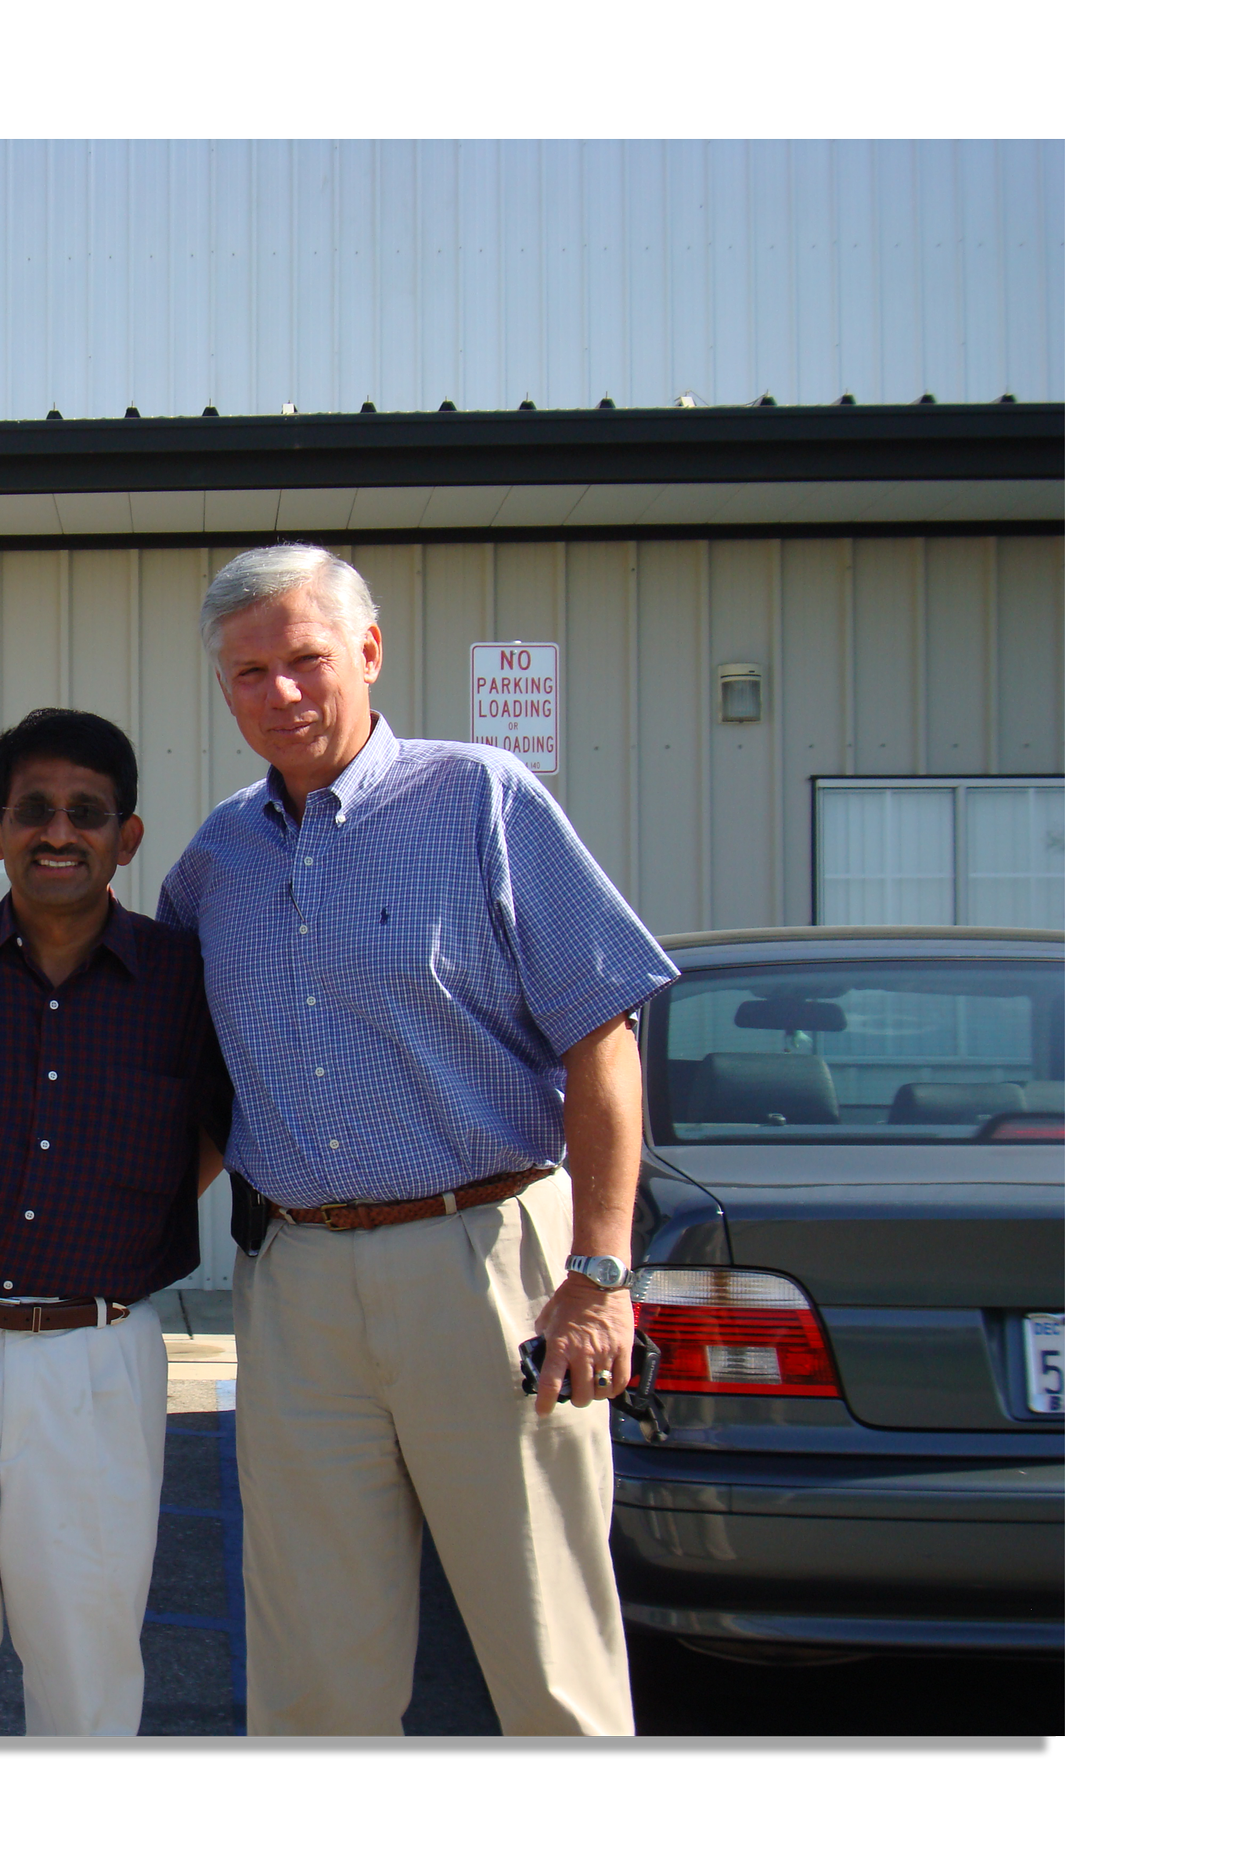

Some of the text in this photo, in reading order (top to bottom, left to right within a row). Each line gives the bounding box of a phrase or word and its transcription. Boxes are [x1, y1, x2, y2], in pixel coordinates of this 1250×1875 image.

[500, 650, 531, 671] NO
[476, 677, 553, 694] PARKING
[478, 699, 552, 718] LOADING
[508, 722, 519, 731] OR
[1034, 1322, 1061, 1336] DEC
[1040, 1349, 1063, 1395] 5
